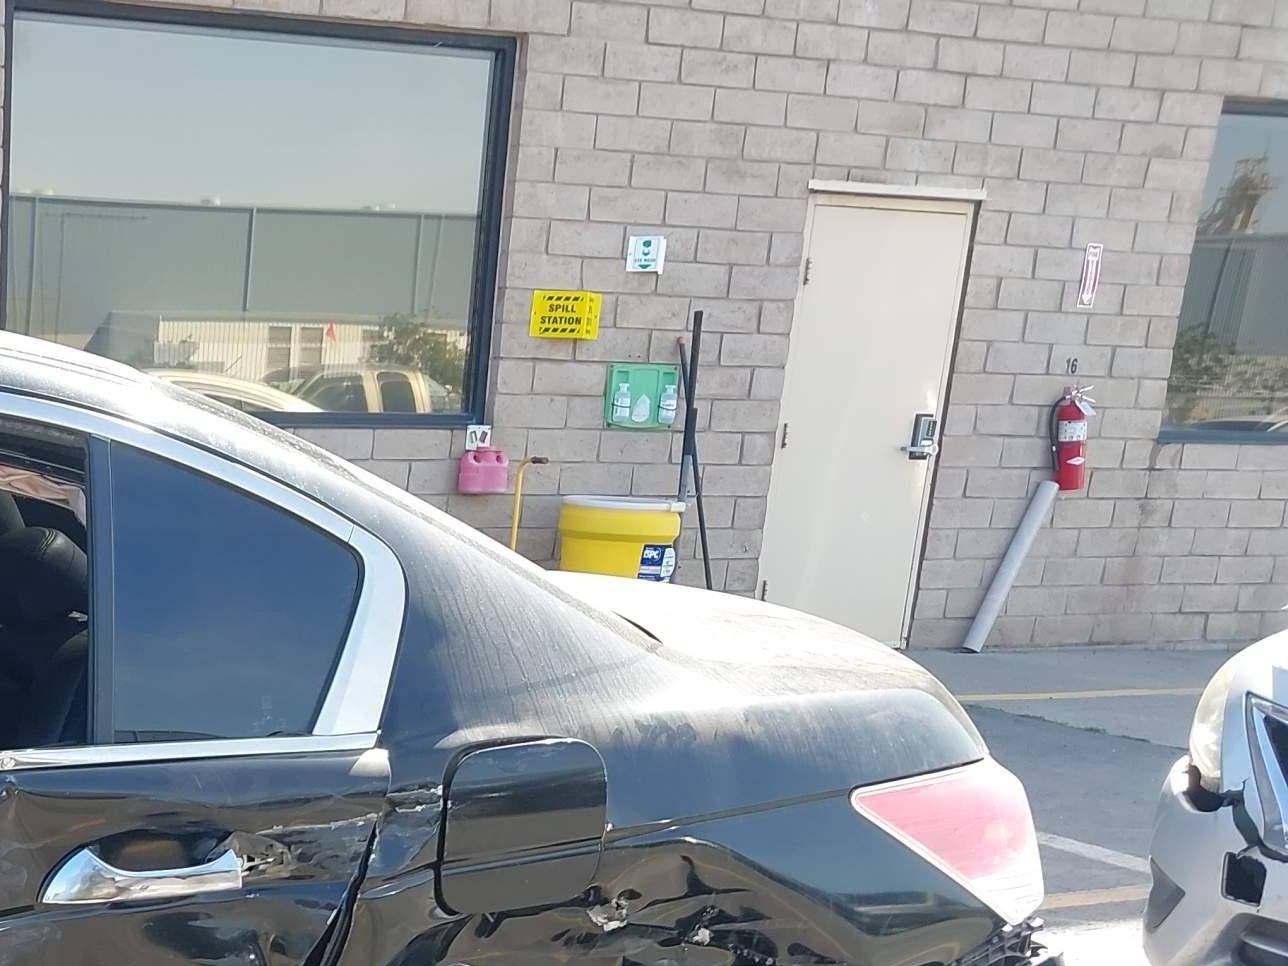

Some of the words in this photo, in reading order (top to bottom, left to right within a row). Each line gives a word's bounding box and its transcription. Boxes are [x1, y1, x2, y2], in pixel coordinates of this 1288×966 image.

[548, 304, 576, 313] SPILL
[540, 316, 582, 325] STATION
[1066, 358, 1078, 374] 16
